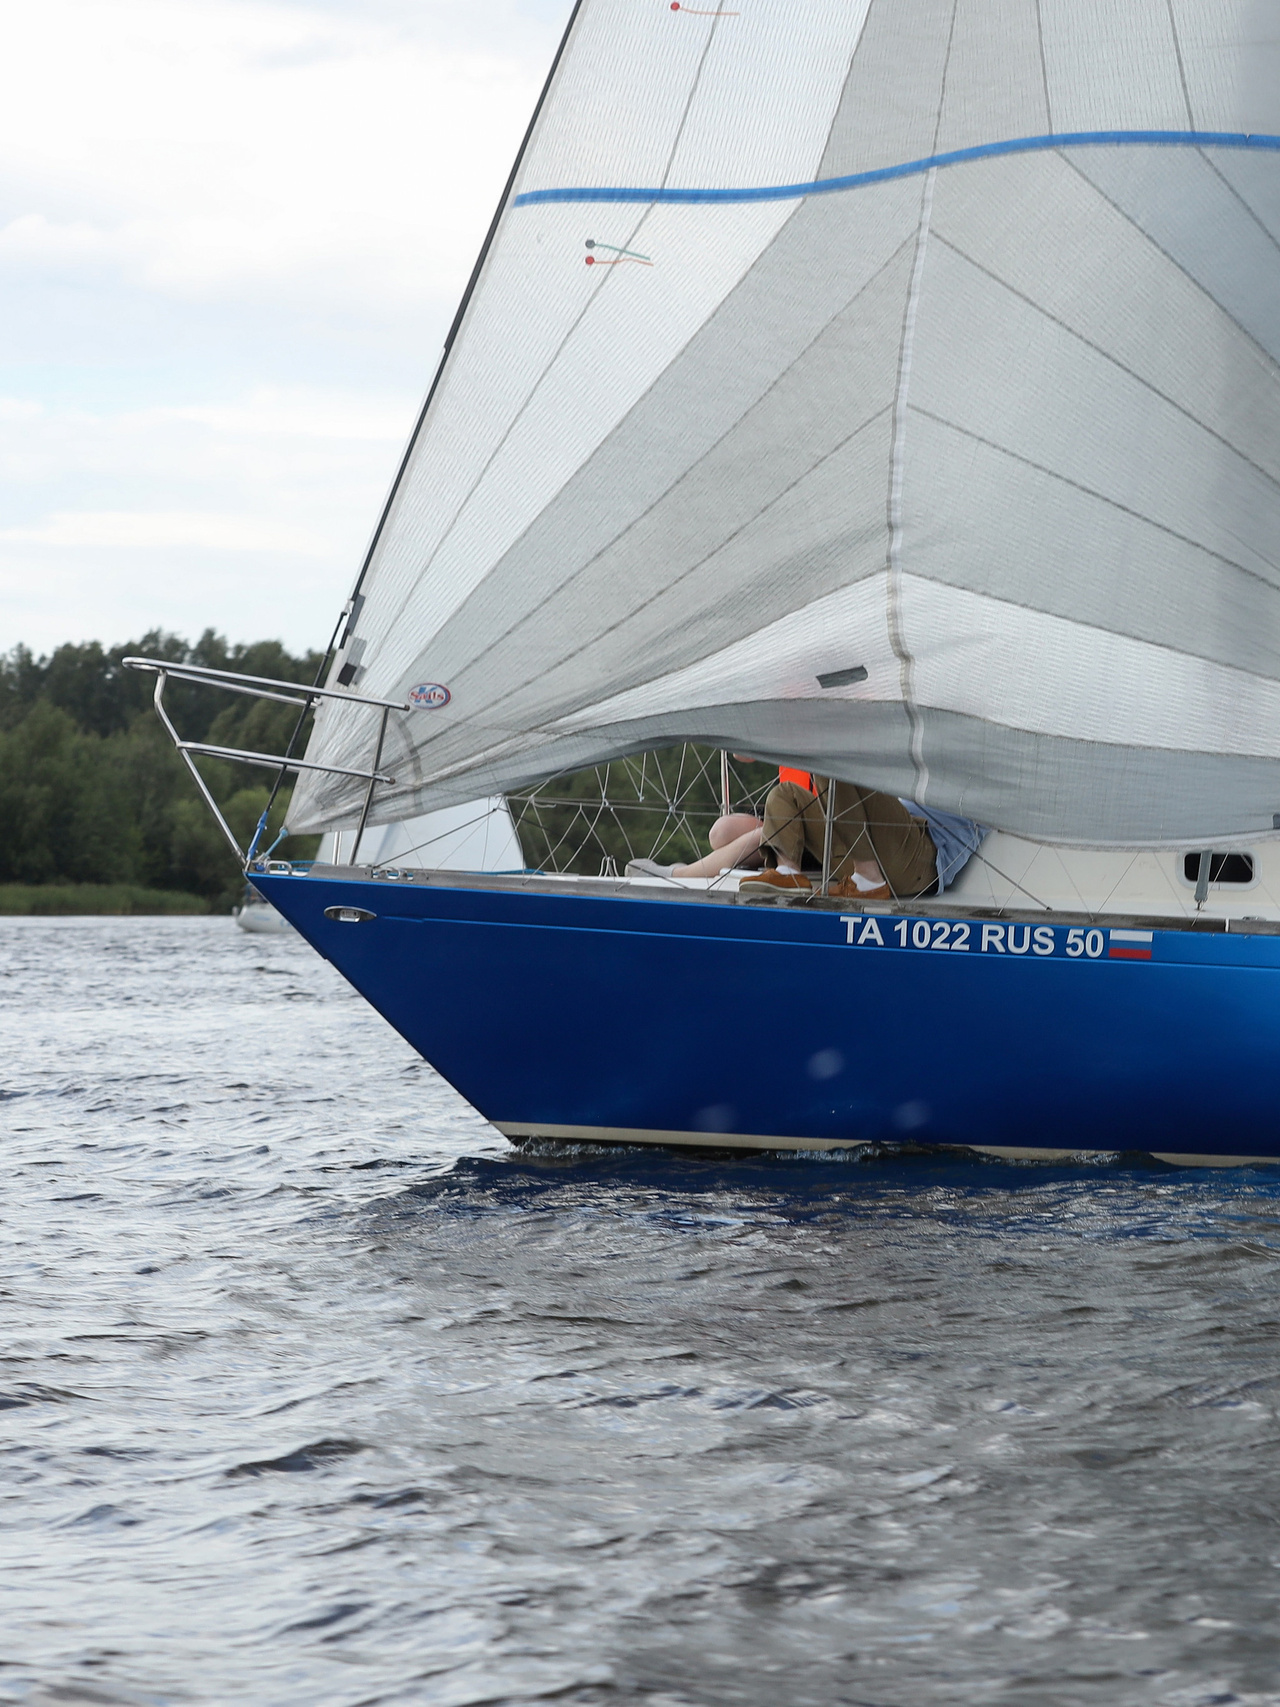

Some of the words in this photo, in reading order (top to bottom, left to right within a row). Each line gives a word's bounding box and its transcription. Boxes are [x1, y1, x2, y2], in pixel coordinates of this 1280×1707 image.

[839, 916, 885, 946] TA
[893, 919, 971, 951] 1022
[980, 923, 1056, 956] RUS
[1065, 929, 1104, 958] 50
